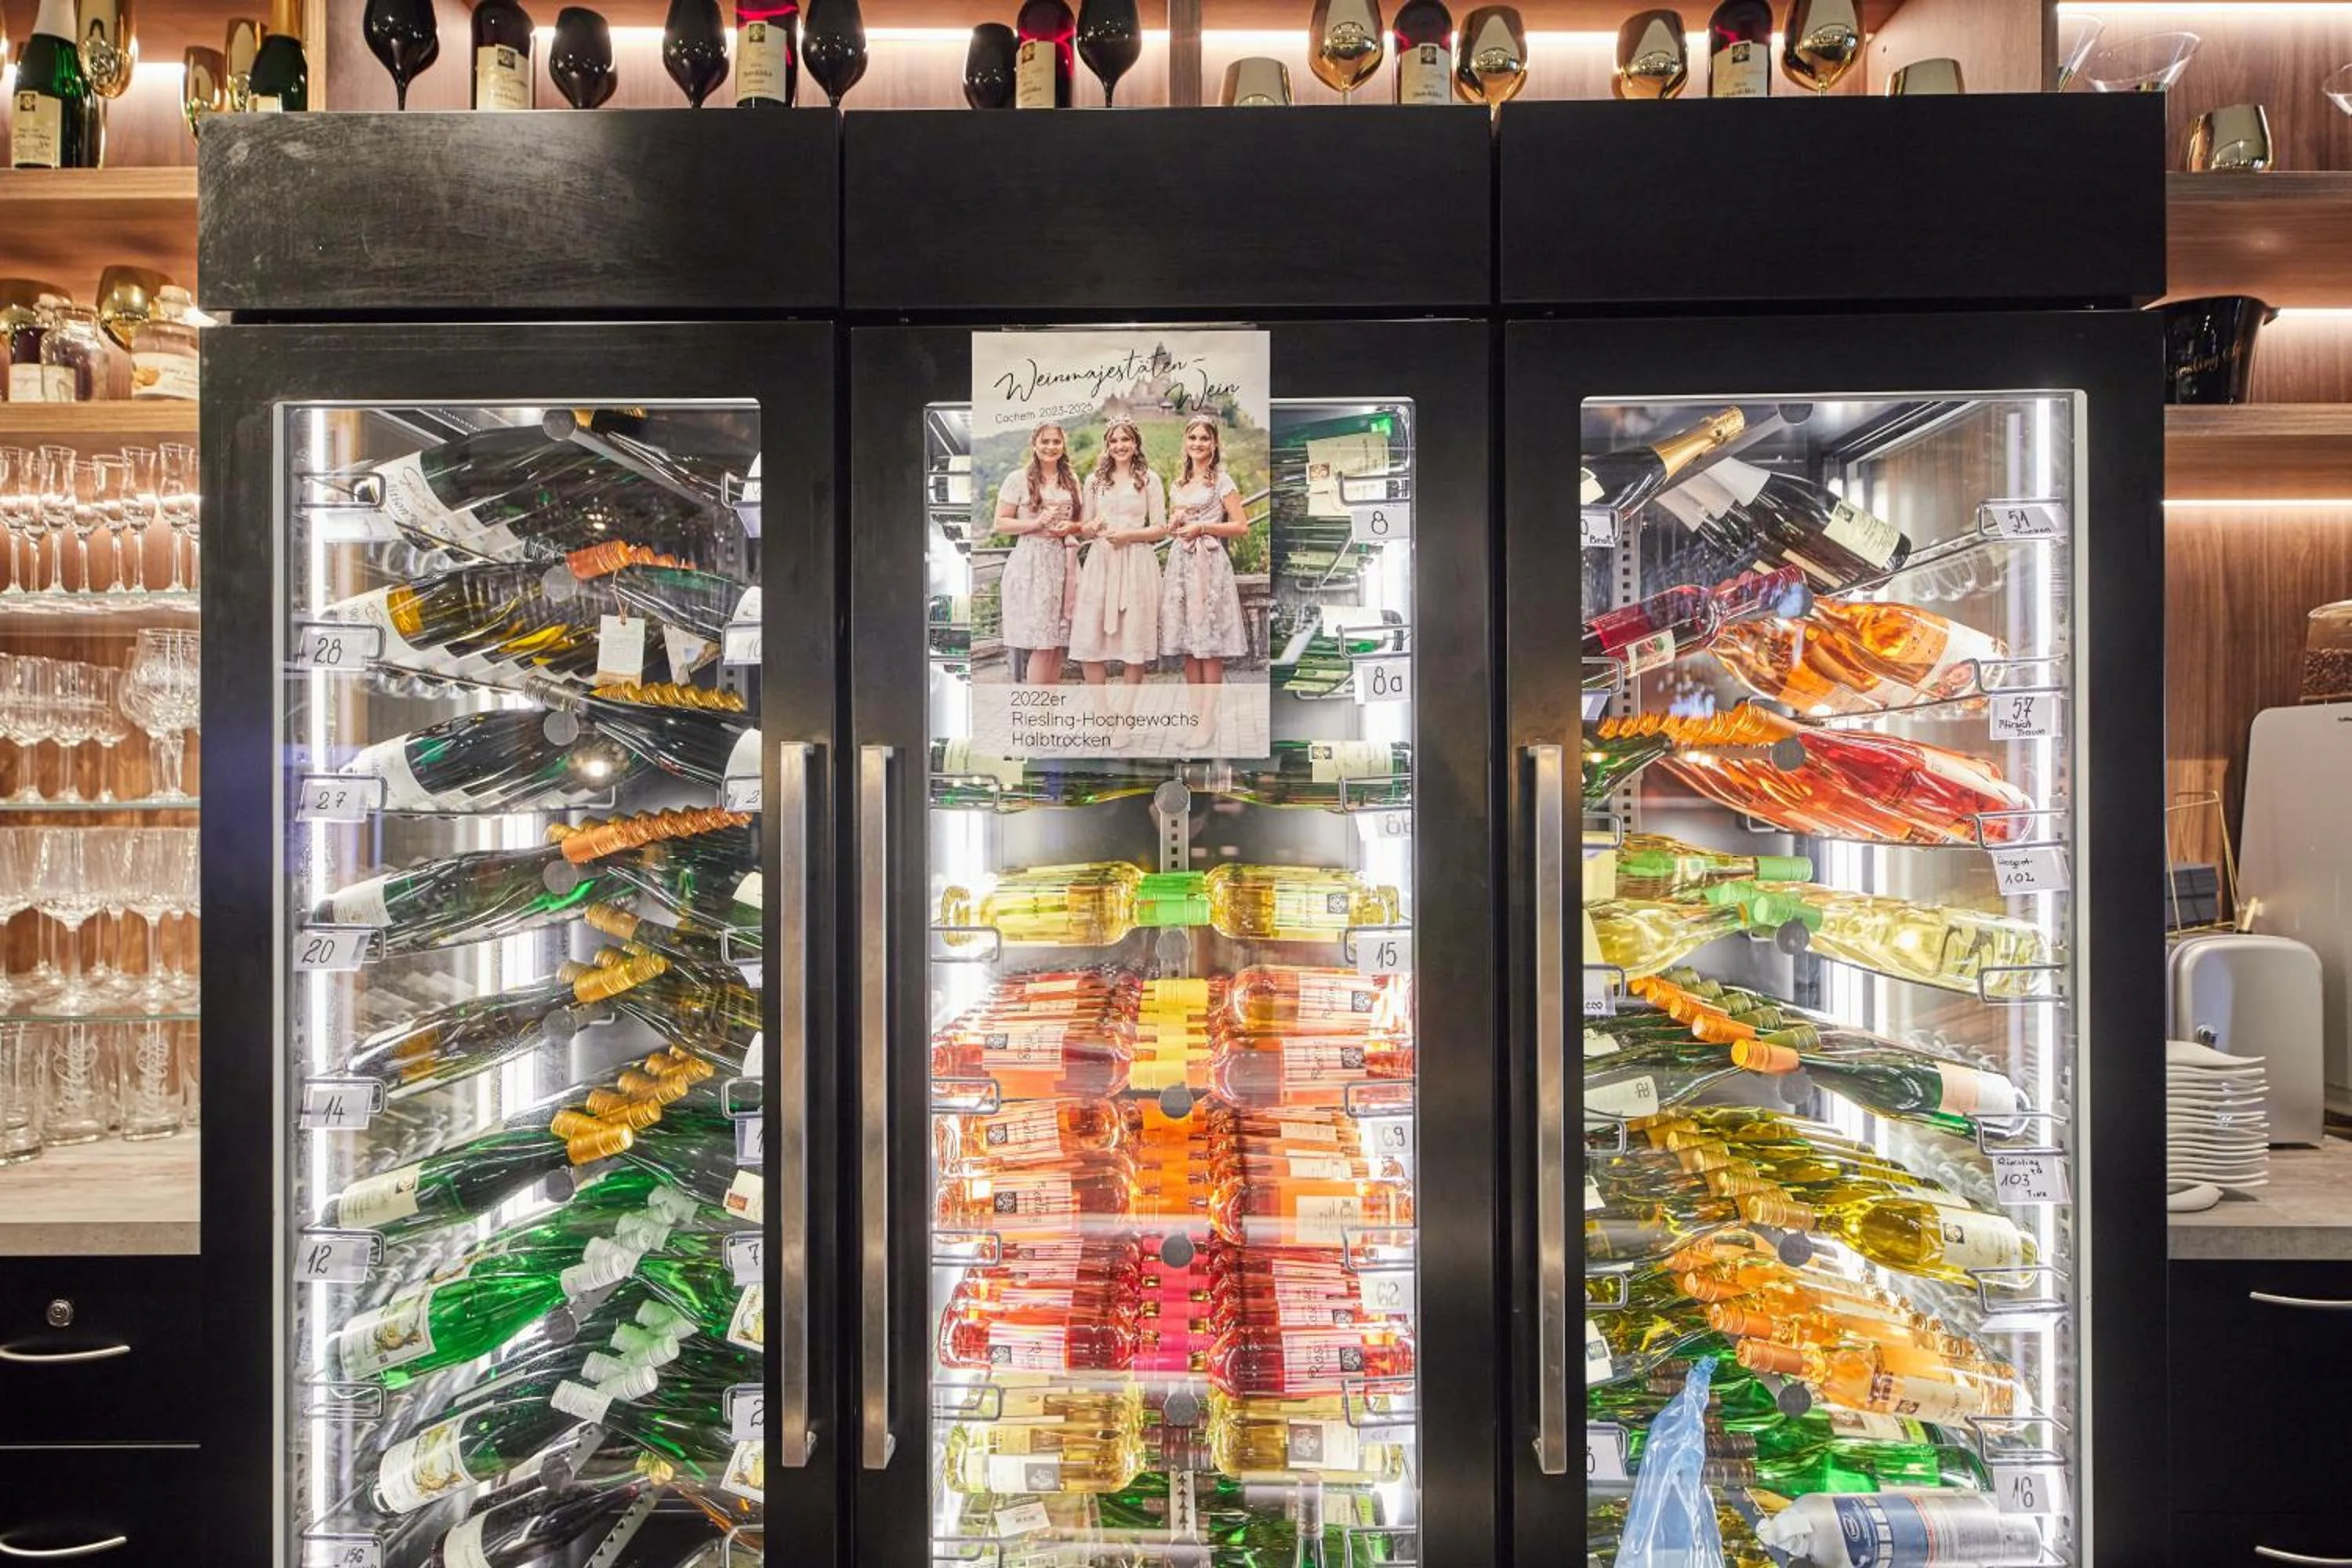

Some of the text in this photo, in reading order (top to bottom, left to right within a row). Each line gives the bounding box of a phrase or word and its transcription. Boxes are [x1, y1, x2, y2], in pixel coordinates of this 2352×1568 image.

[1165, 368, 1243, 412] Wein
[995, 412, 1036, 424] Cochem
[1370, 510, 1388, 535] 8
[314, 637, 343, 665] 28
[1373, 666, 1403, 695] 8a
[1011, 691, 1067, 706] 2022er
[2013, 696, 2035, 720] 57
[1011, 731, 1111, 747] Halbtrocken
[315, 791, 347, 810] 27
[2004, 872, 2034, 885] 102
[301, 938, 336, 964] 20
[1376, 942, 1396, 969] 15
[323, 1095, 346, 1124] 14
[2000, 1174, 2031, 1187] 103
[307, 1243, 332, 1274] 12
